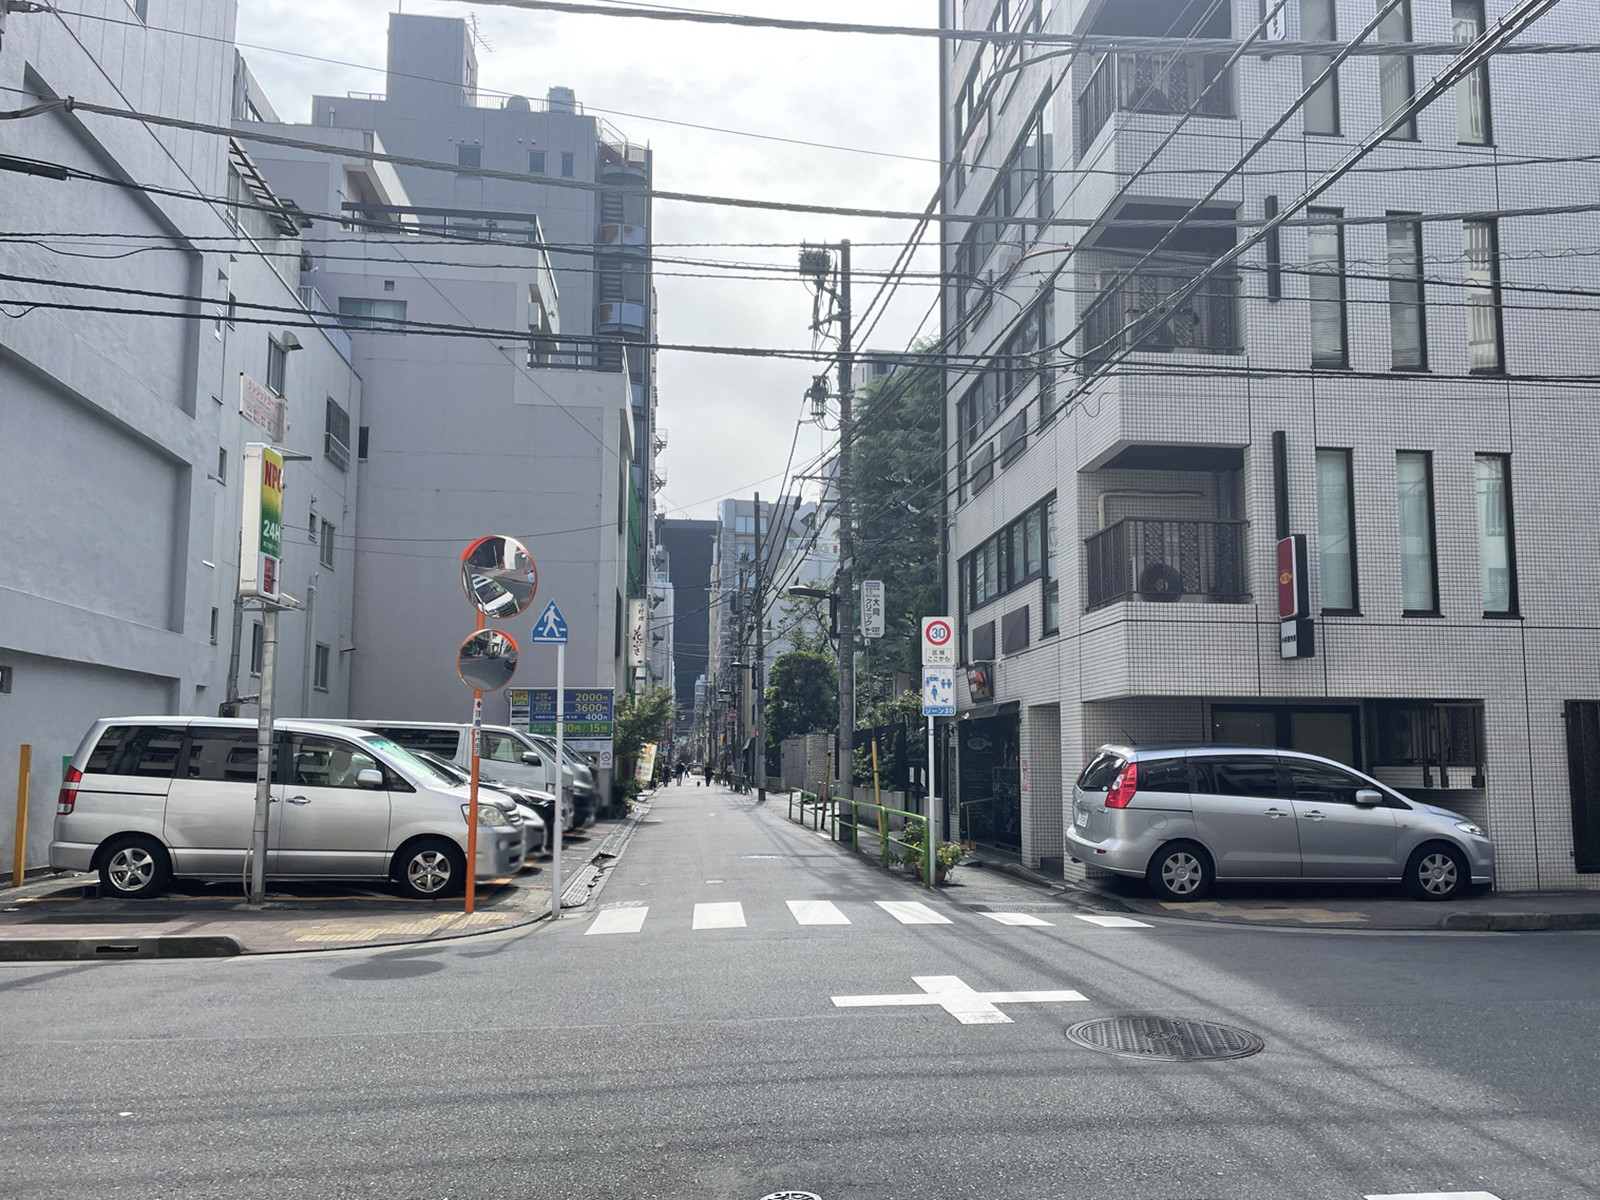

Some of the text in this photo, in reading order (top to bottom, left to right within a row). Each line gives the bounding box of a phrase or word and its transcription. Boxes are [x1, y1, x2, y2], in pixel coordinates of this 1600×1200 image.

[931, 627, 946, 639] 30
[575, 693, 608, 701] 2000円
[574, 703, 608, 712] 3600円
[585, 713, 608, 721] 400円
